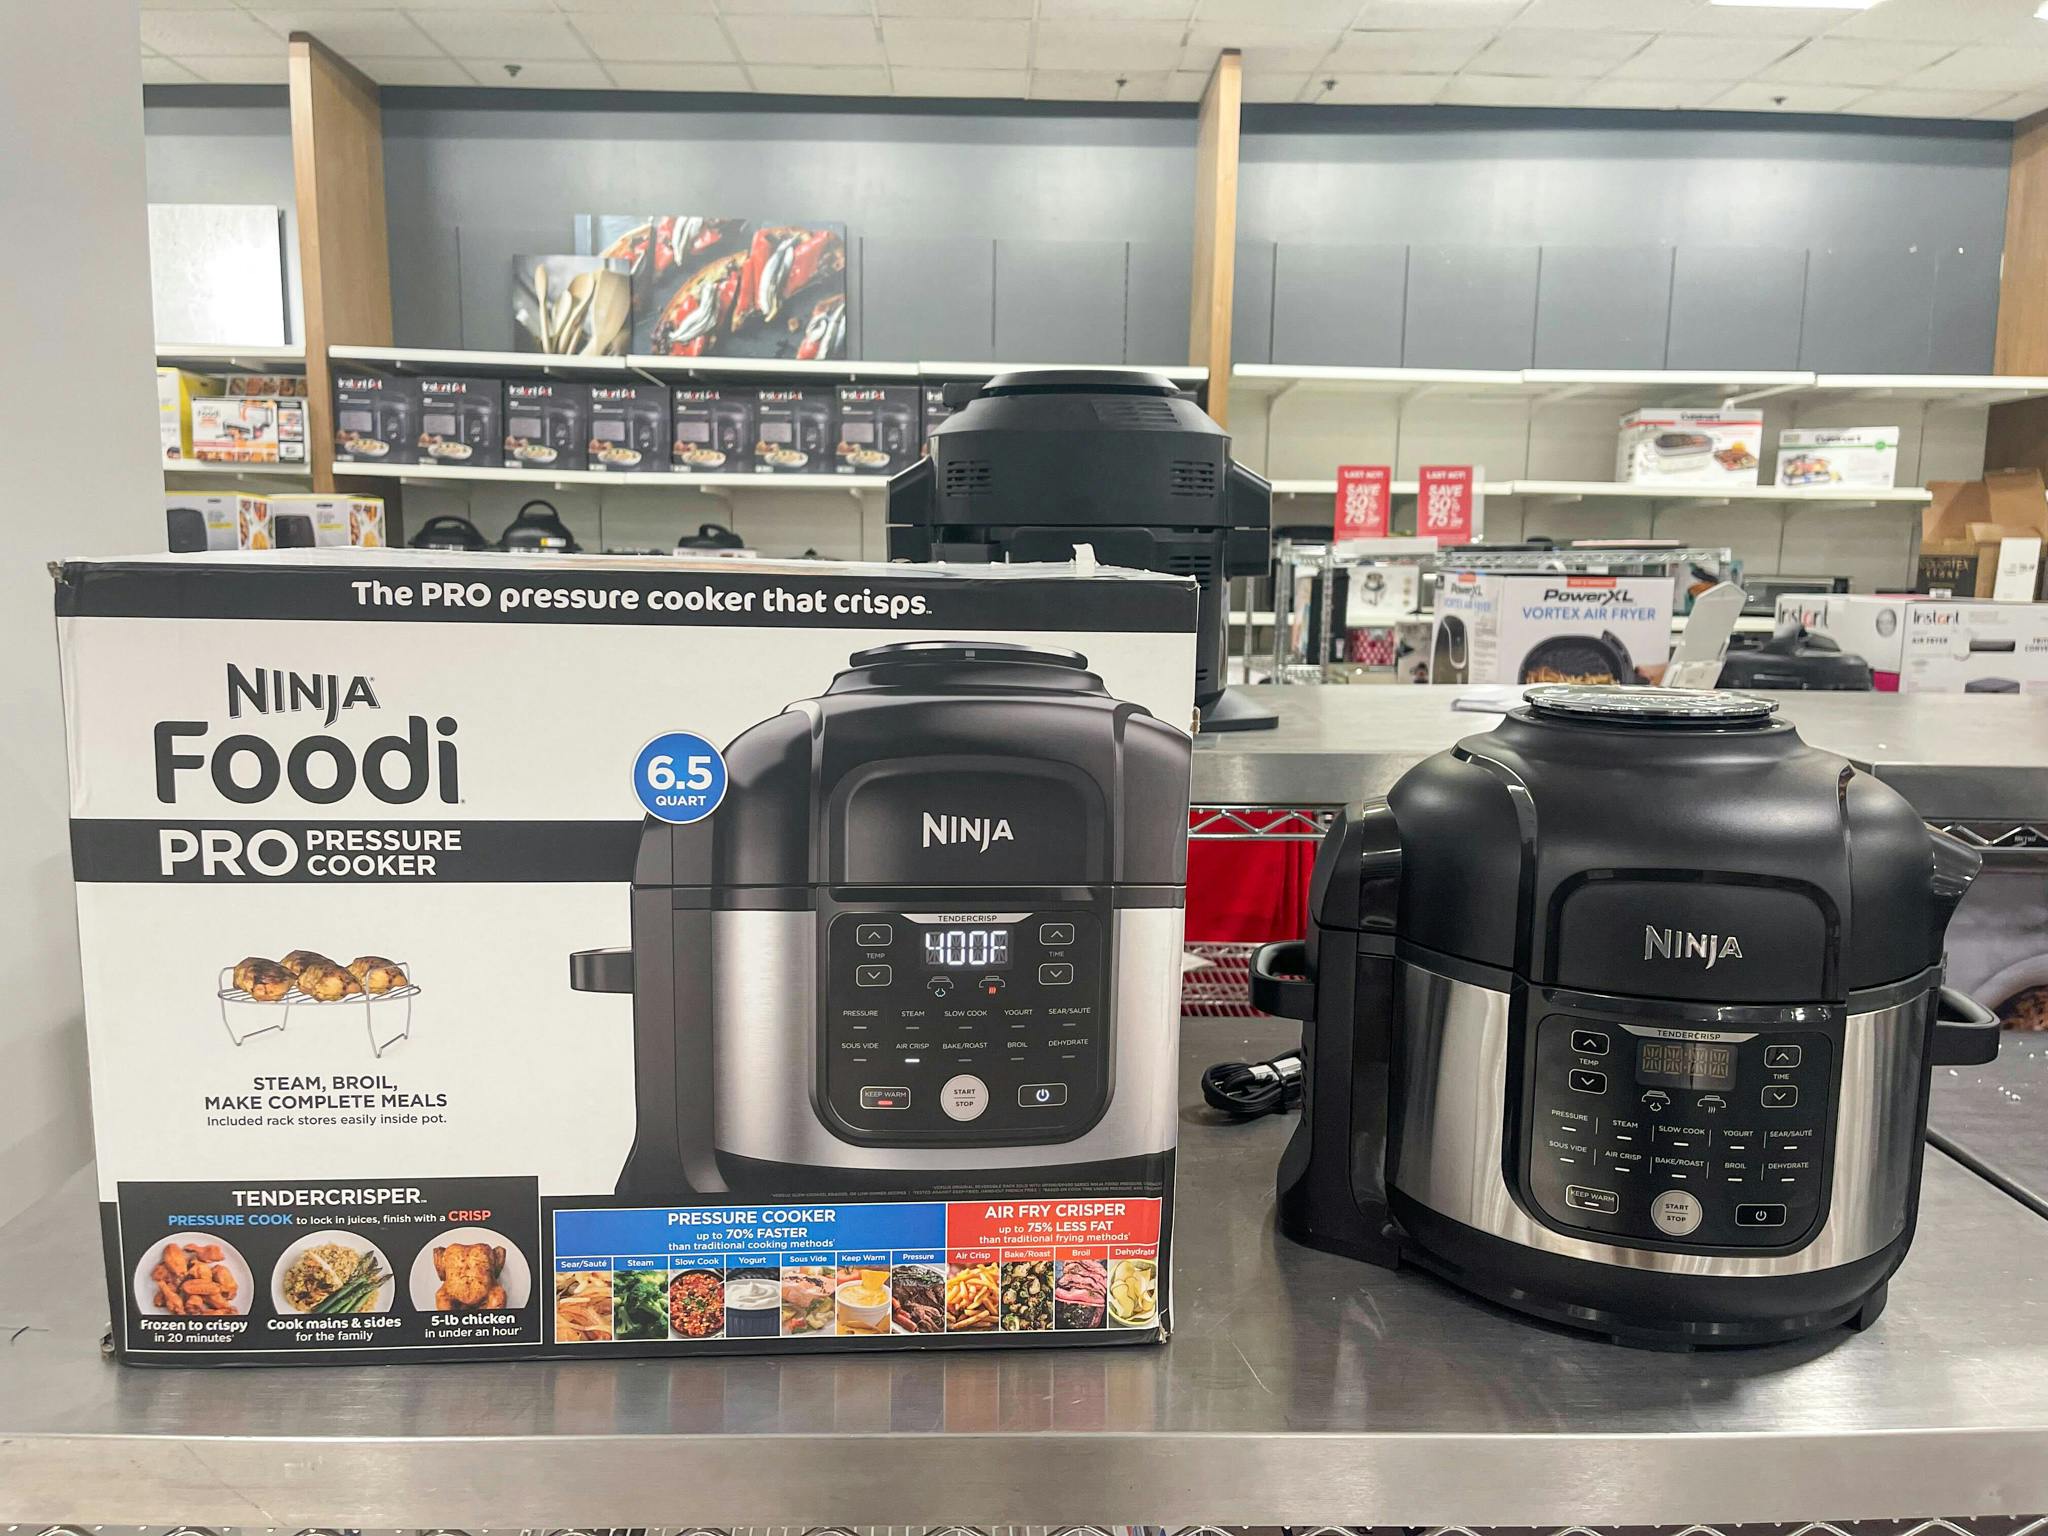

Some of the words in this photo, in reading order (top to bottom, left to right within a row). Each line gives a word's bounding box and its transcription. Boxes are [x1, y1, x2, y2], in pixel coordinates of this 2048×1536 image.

[1346, 483, 1381, 496] SAVE
[1428, 484, 1464, 497] SAVE
[352, 581, 413, 607] The
[421, 582, 492, 608] PRO
[500, 588, 639, 613] pressure
[648, 587, 756, 613] cooker
[763, 587, 827, 613] that
[1544, 589, 1634, 605] PowerXL
[1523, 607, 1580, 620] VORTEX
[1584, 608, 1606, 620] AIR
[1612, 608, 1656, 621] FRYER
[1913, 608, 1959, 625] Instant
[226, 662, 381, 727] NINJA
[154, 715, 460, 804] Foodi
[647, 754, 713, 790] 6.5
[655, 795, 706, 807] QUART
[922, 811, 1014, 854] NINJA
[159, 828, 299, 876] PRO
[306, 829, 462, 852] PRESSURE
[306, 854, 437, 877] COOKER
[938, 915, 997, 923] TENDERCRISP
[1644, 925, 1743, 970] NINJA
[1657, 1029, 1721, 1041] TENDERCRISP
[943, 1041, 988, 1049] BAKE/ROAST
[1048, 1038, 1089, 1047] DEHYDRATE
[1578, 1058, 1600, 1067] TEMP
[253, 1076, 326, 1092] STEAM,
[332, 1075, 398, 1091] BROIL,
[205, 1096, 262, 1110] MAKE
[268, 1095, 376, 1110] COMPLETE
[382, 1093, 448, 1108] MEALS
[207, 1115, 263, 1126] Included
[267, 1115, 295, 1126] rack
[298, 1116, 336, 1126] stores
[340, 1114, 377, 1127] easily
[380, 1113, 418, 1125] inside
[421, 1114, 447, 1127] pot.
[1551, 1109, 1589, 1122] PRESSURE
[1612, 1119, 1639, 1129] STEAM
[1658, 1125, 1681, 1134] SLOW
[1683, 1127, 1705, 1136] COOK
[1723, 1130, 1754, 1138] YOGURT
[1549, 1140, 1567, 1150] SOUS
[1568, 1143, 1587, 1152] VIDE
[1605, 1151, 1618, 1159] AIR
[1620, 1153, 1642, 1161] CRISP
[1655, 1156, 1704, 1167] BAKE/ROAST
[1724, 1162, 1746, 1170] BROIL
[1768, 1162, 1809, 1170] DEHYDRATE
[232, 1187, 421, 1207] TENDERCRISPER
[1570, 1190, 1589, 1200] KEEP
[1590, 1192, 1615, 1202] WARM
[985, 1205, 1014, 1219] AIR
[1019, 1205, 1051, 1218] FRY
[1055, 1203, 1126, 1217] CRISPER
[1665, 1203, 1689, 1211] START
[168, 1214, 245, 1227] PRESSURE
[248, 1213, 293, 1226] COOK
[296, 1216, 308, 1226] to
[310, 1214, 333, 1226] lock
[335, 1214, 345, 1225] in
[346, 1214, 381, 1227] juices,
[383, 1212, 412, 1225] finish
[414, 1213, 437, 1223] with
[448, 1210, 491, 1222] CRISP
[668, 1211, 757, 1226] PRESSURE
[762, 1209, 836, 1224] COOKER
[999, 1225, 1012, 1235] up
[1013, 1225, 1024, 1234] to
[1027, 1222, 1053, 1233] 75%
[1056, 1221, 1087, 1232] LESS
[1090, 1220, 1114, 1231] FAT
[696, 1231, 708, 1241] up
[711, 1231, 724, 1240] to
[726, 1228, 754, 1239] 70%
[757, 1227, 808, 1239] FASTER
[979, 1235, 1001, 1244] than
[1003, 1234, 1053, 1244] traditional
[1055, 1233, 1084, 1244] frying
[668, 1241, 692, 1251] than
[694, 1240, 745, 1250] traditional
[748, 1239, 788, 1251] cooking
[841, 1254, 862, 1264] Keep
[863, 1253, 886, 1262] Warm
[902, 1252, 935, 1261] Pressure
[955, 1251, 968, 1260] Air
[970, 1251, 991, 1262] Crisp
[1004, 1249, 1051, 1259] Bake/Roast
[1072, 1249, 1091, 1257] Broil
[1115, 1248, 1155, 1257] Dehydrate
[561, 1258, 607, 1269] Sear/Sauté
[627, 1258, 654, 1267] Steam
[675, 1257, 696, 1266] Slow
[698, 1257, 719, 1265] Cook
[738, 1255, 766, 1266] Yogurt
[789, 1255, 808, 1263] Sous
[810, 1255, 828, 1263] Vide
[267, 1318, 303, 1330] Cook
[306, 1318, 348, 1330] mains
[351, 1317, 362, 1329] &
[364, 1316, 402, 1329] sides
[431, 1314, 459, 1326] 5-lb
[462, 1313, 516, 1325] chicken
[140, 1319, 185, 1331] Frozen
[188, 1320, 202, 1331] to
[205, 1319, 248, 1333] crispy
[154, 1332, 165, 1342] in
[167, 1333, 183, 1343] 20
[296, 1330, 312, 1342] for
[315, 1330, 333, 1341] the
[337, 1329, 374, 1343] family
[425, 1328, 436, 1338] in
[438, 1328, 472, 1338] under
[475, 1328, 489, 1337] an
